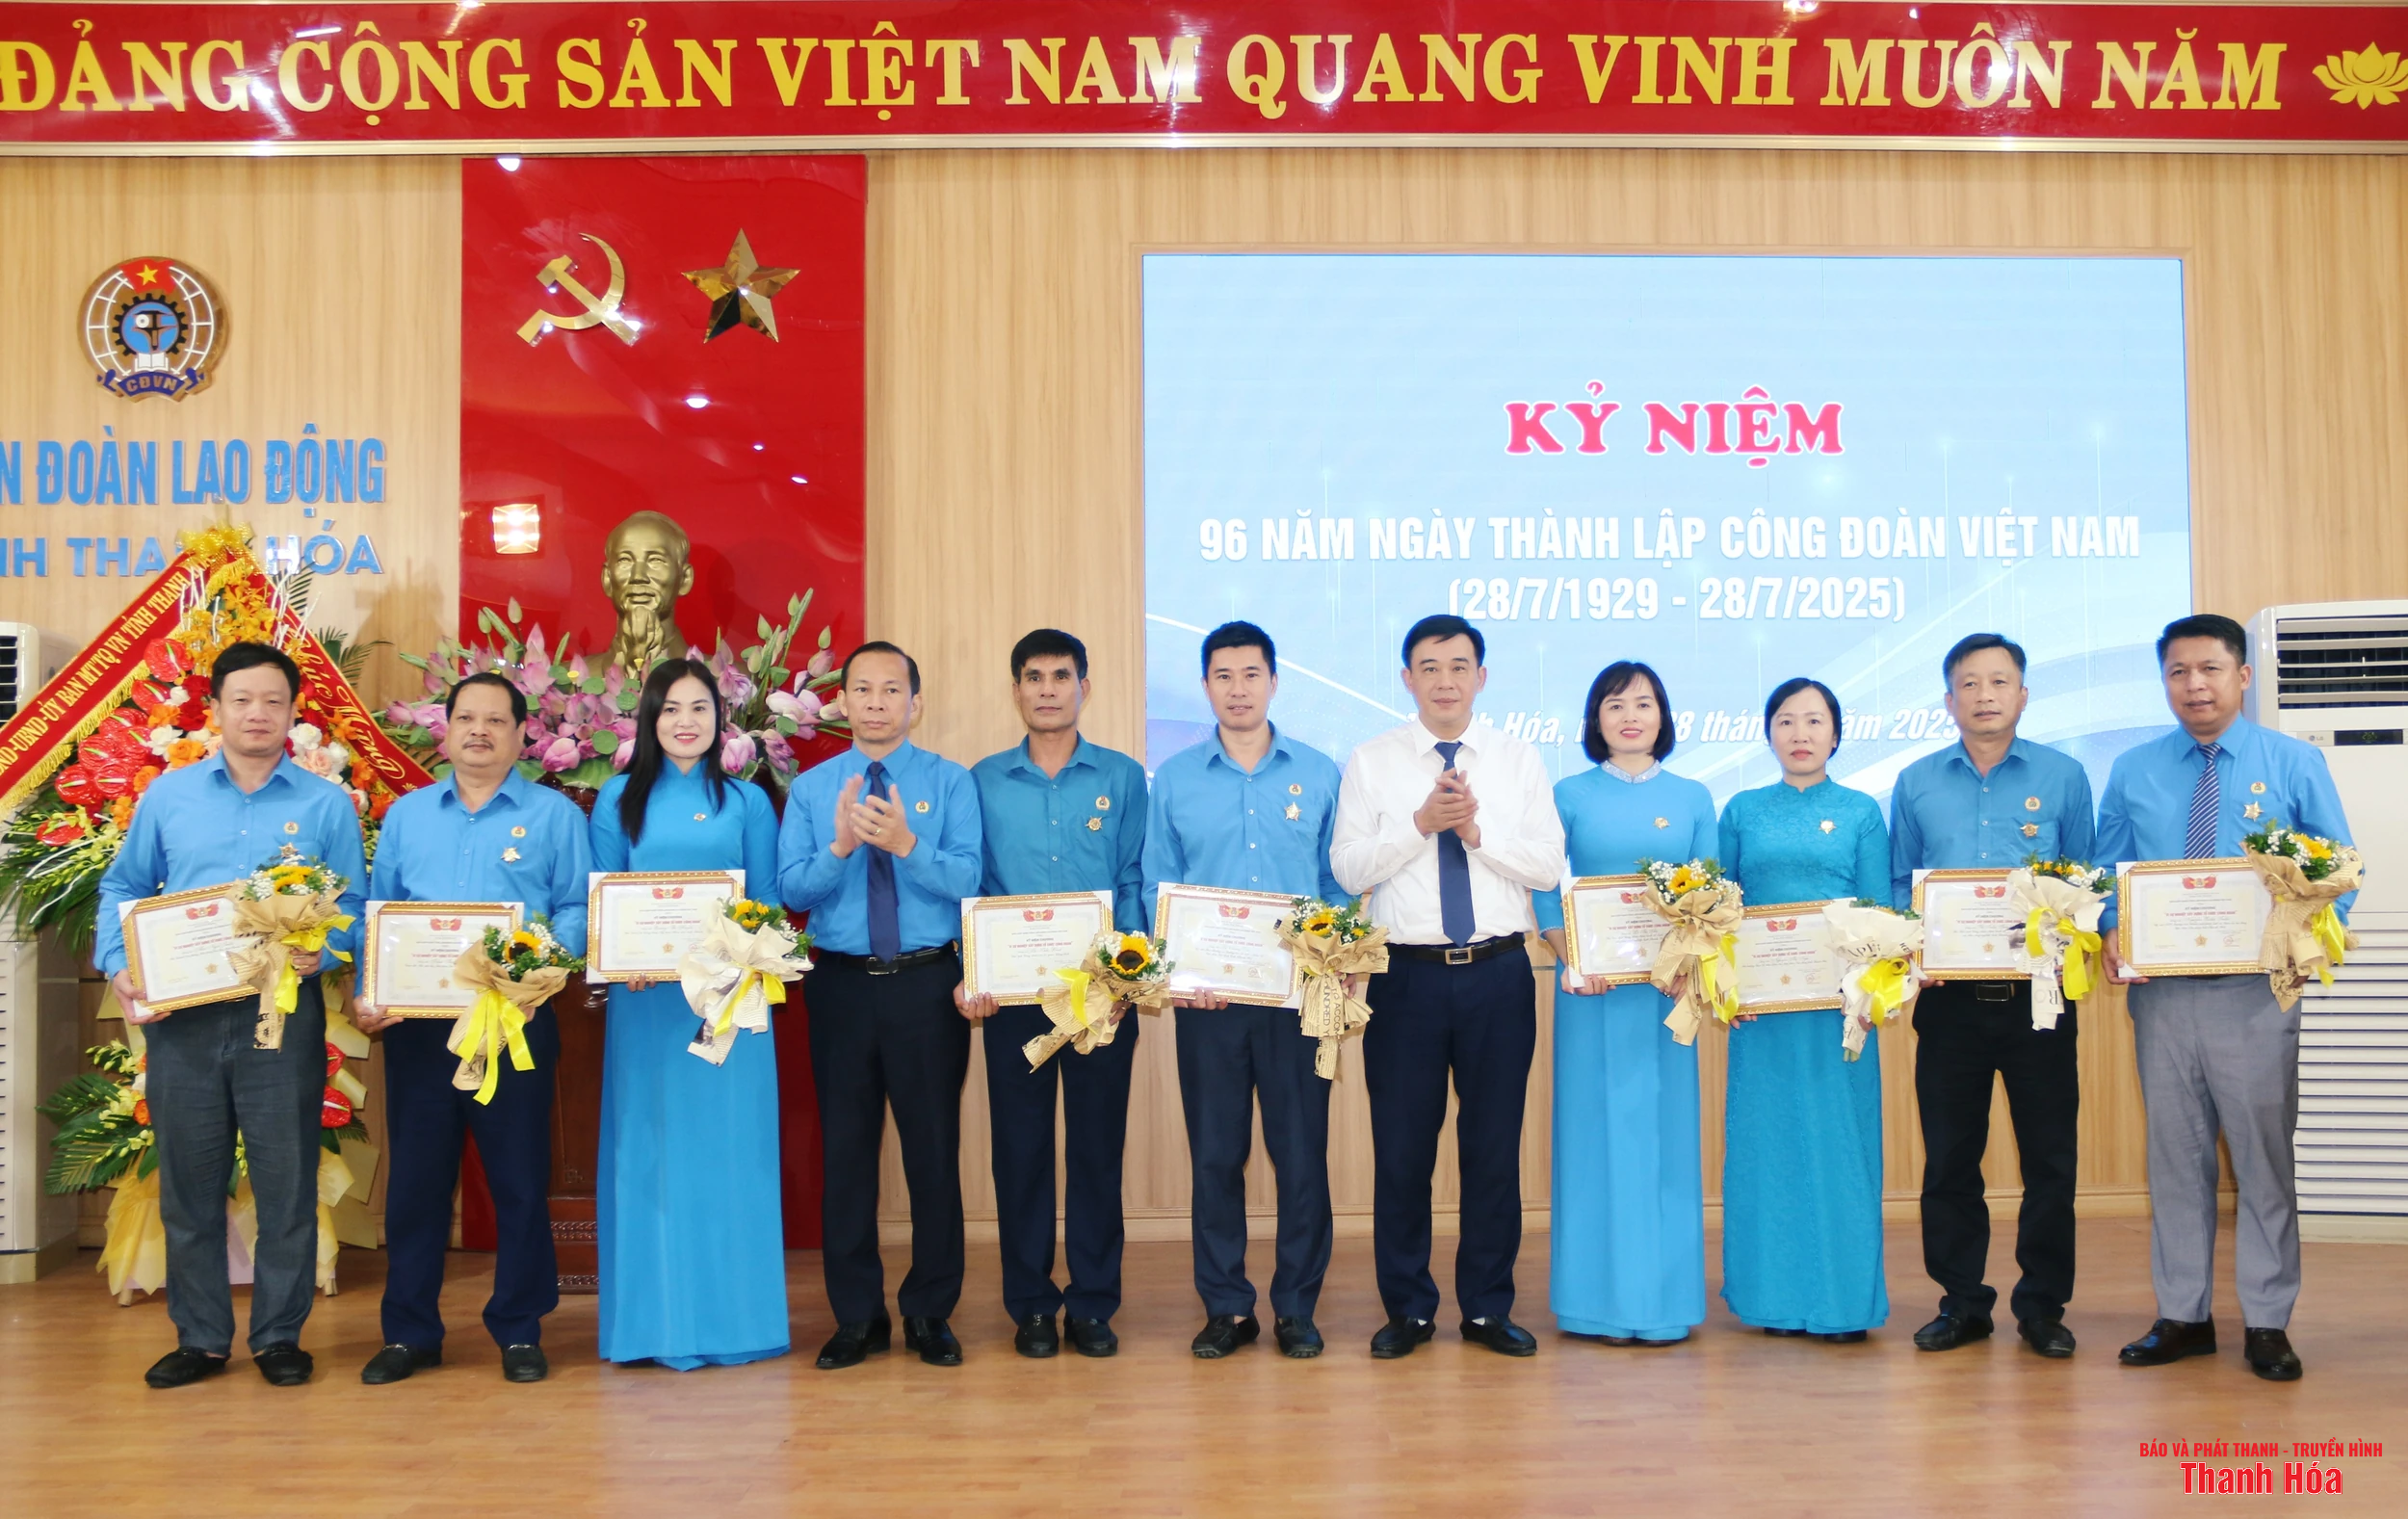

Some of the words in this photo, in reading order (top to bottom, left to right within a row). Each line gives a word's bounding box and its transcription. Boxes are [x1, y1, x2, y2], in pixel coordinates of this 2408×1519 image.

[0, 19, 251, 112] ĐẢNG
[279, 20, 529, 125] CỘNG
[558, 17, 734, 108] SẢN
[757, 23, 981, 121] VIỆT
[1004, 36, 1203, 105] NAM
[1226, 33, 1543, 119] QUANG
[1568, 35, 1794, 105] VINH
[1820, 23, 2072, 108] MUÔN
[2092, 27, 2288, 110] NĂM
[1505, 381, 1621, 455] KỶ
[1642, 386, 1845, 467] NIỆM
[37, 426, 158, 505] ĐOÀN
[172, 438, 250, 504] LAO
[264, 423, 385, 517] ĐỘNG
[66, 537, 183, 577] THA
[265, 519, 383, 576] HÓA
[1200, 518, 1247, 561] 96
[1262, 509, 1354, 560] NĂM
[1369, 508, 1476, 560] NGÀY
[1488, 508, 1620, 559] THÀNH
[1634, 508, 1706, 568] LẬP
[1720, 508, 1826, 559] CÔNG
[1839, 508, 1946, 558] ĐOÀN
[1958, 508, 2038, 566] VIỆT
[2051, 516, 2139, 557] NAM
[1449, 576, 1659, 620] (28/7/1929
[1699, 575, 1905, 622] 28/7/2025)
[55, 676, 89, 708] BAN
[104, 631, 132, 655] VN
[120, 606, 158, 640] TỈNH
[146, 571, 192, 615] THANH
[1503, 710, 1565, 748] Hóa,
[1699, 708, 1769, 746] thán
[1841, 707, 1883, 741] ăm
